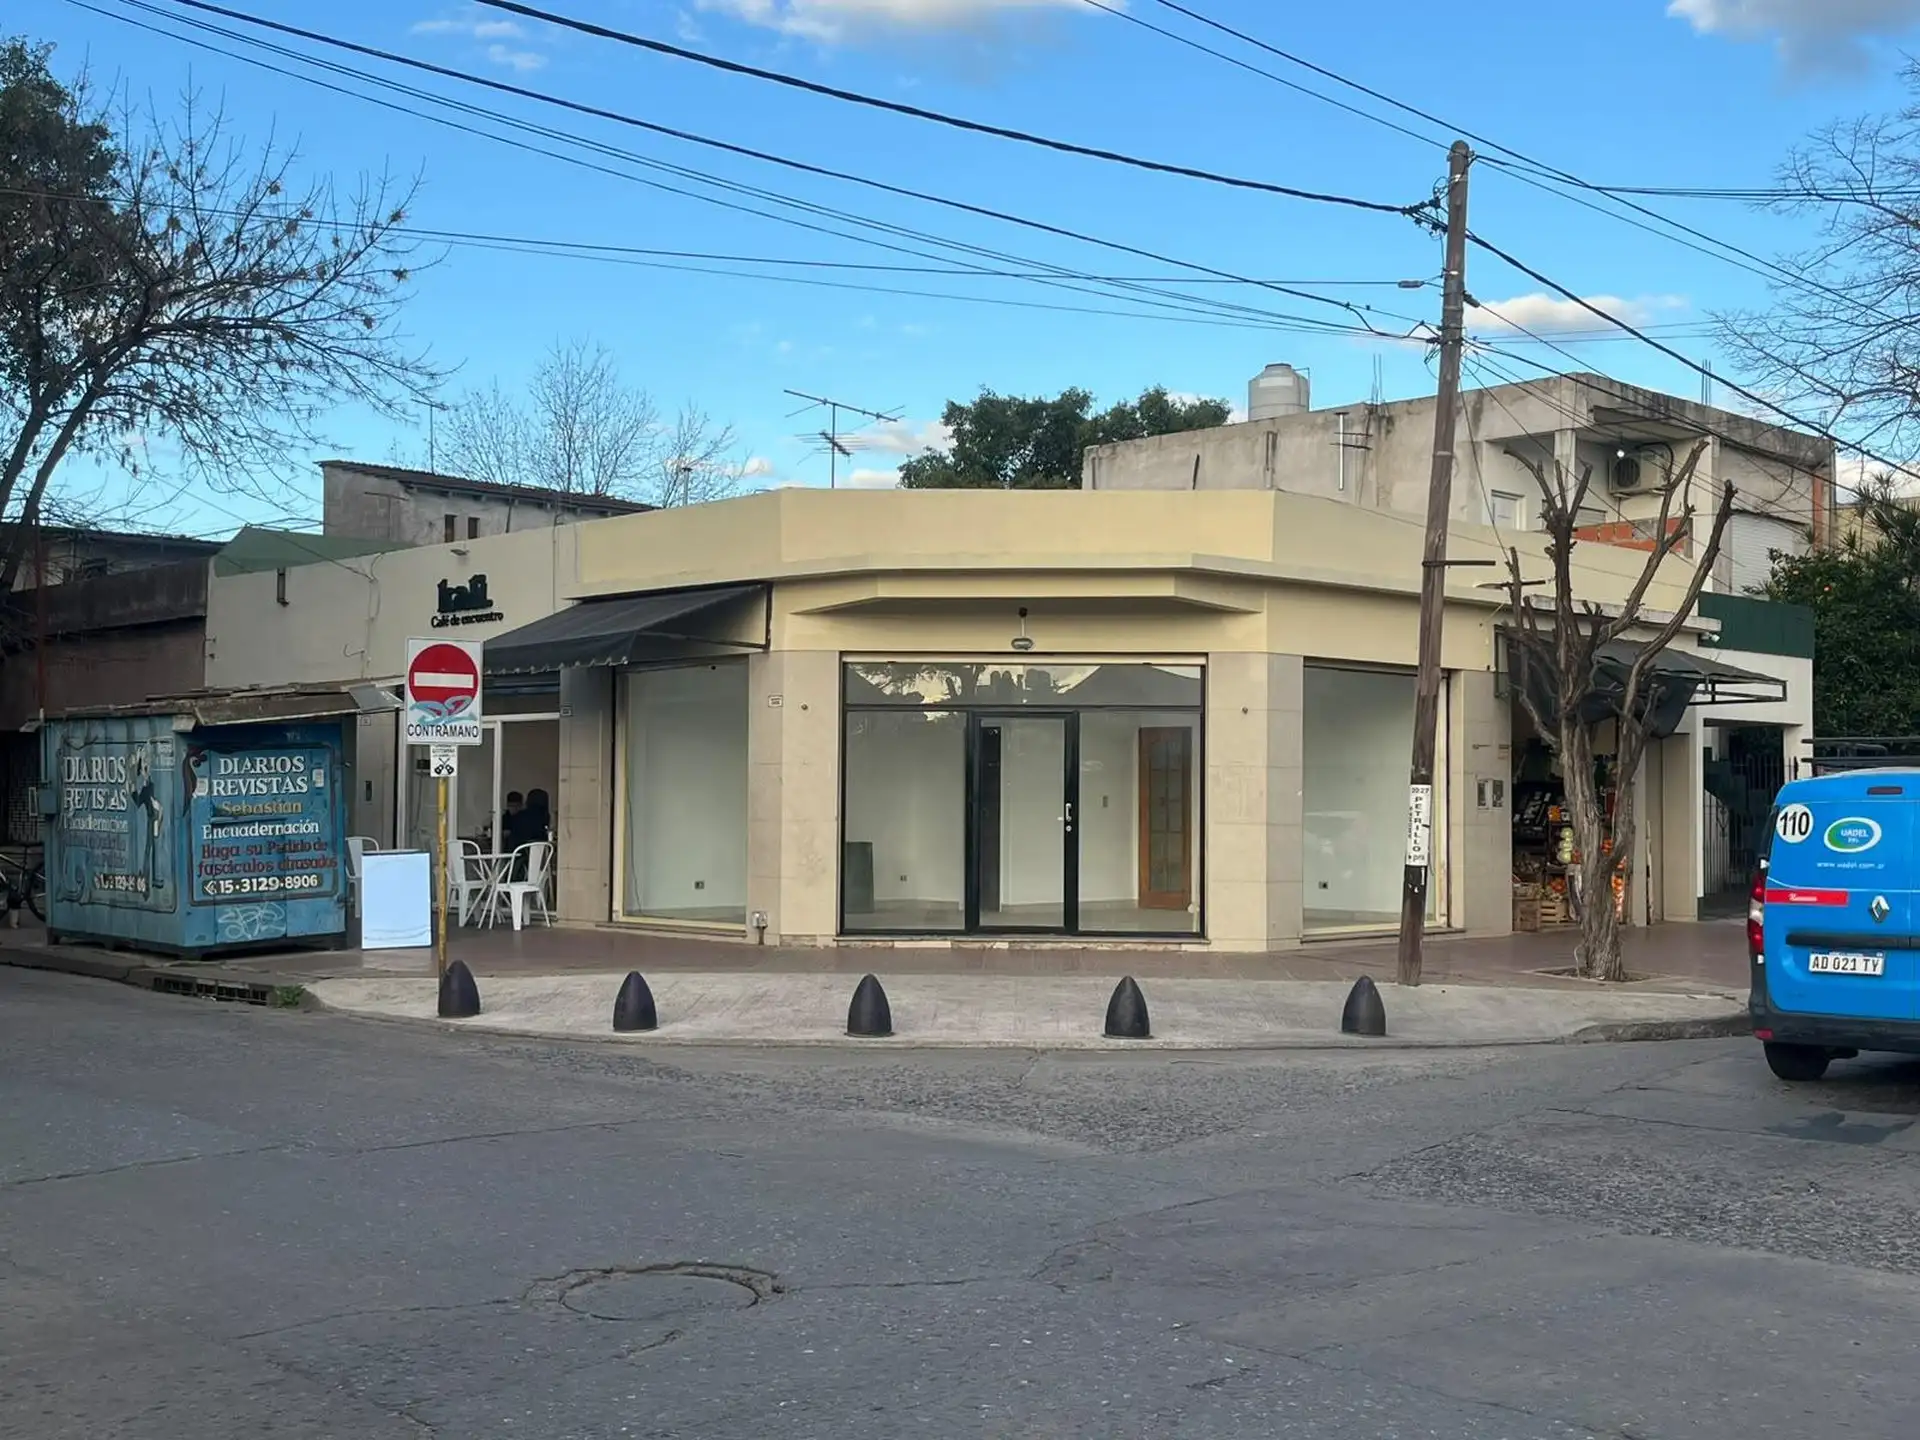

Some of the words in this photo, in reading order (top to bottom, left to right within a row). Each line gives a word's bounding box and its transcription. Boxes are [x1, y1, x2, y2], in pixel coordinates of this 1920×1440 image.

[407, 723, 479, 738] CONTRAMANO
[63, 756, 126, 783] DIARIOS
[217, 756, 305, 775] DIARIOS
[212, 776, 308, 797] REVISTAS
[202, 819, 320, 839] Encuadernación
[1412, 796, 1423, 852] PETRILLO
[1780, 811, 1810, 836] 110
[246, 845, 262, 855] su
[1812, 956, 1828, 970] AD
[1832, 957, 1857, 971] 021
[1862, 959, 1879, 972] TY
